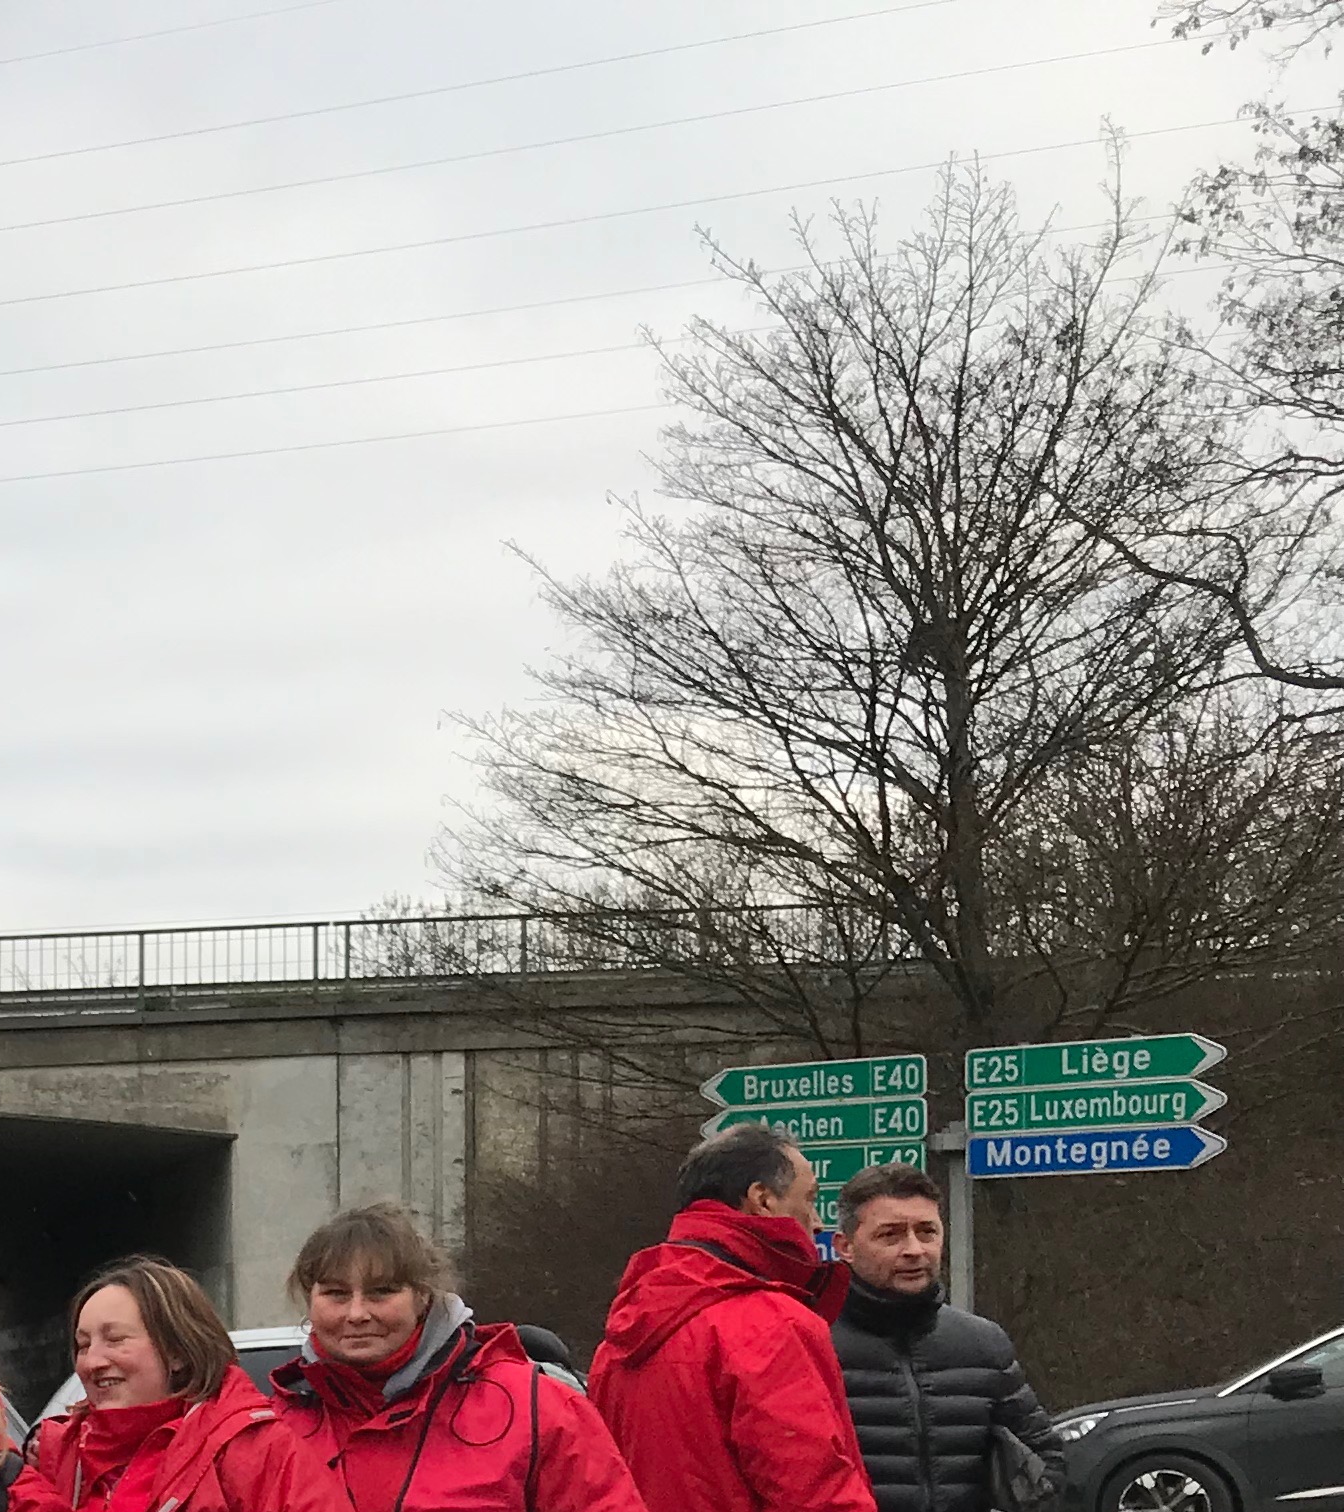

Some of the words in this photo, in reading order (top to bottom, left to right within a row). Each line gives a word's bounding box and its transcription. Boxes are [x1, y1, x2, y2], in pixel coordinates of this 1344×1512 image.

[743, 1070, 855, 1101] Bruxelles
[873, 1062, 920, 1092] E40
[972, 1055, 1019, 1084] E25
[1061, 1047, 1151, 1079] Liège
[873, 1105, 920, 1134] E40
[972, 1099, 1019, 1127] E25
[1029, 1090, 1187, 1121] Luxembourg
[986, 1133, 1171, 1169] Montegnée
